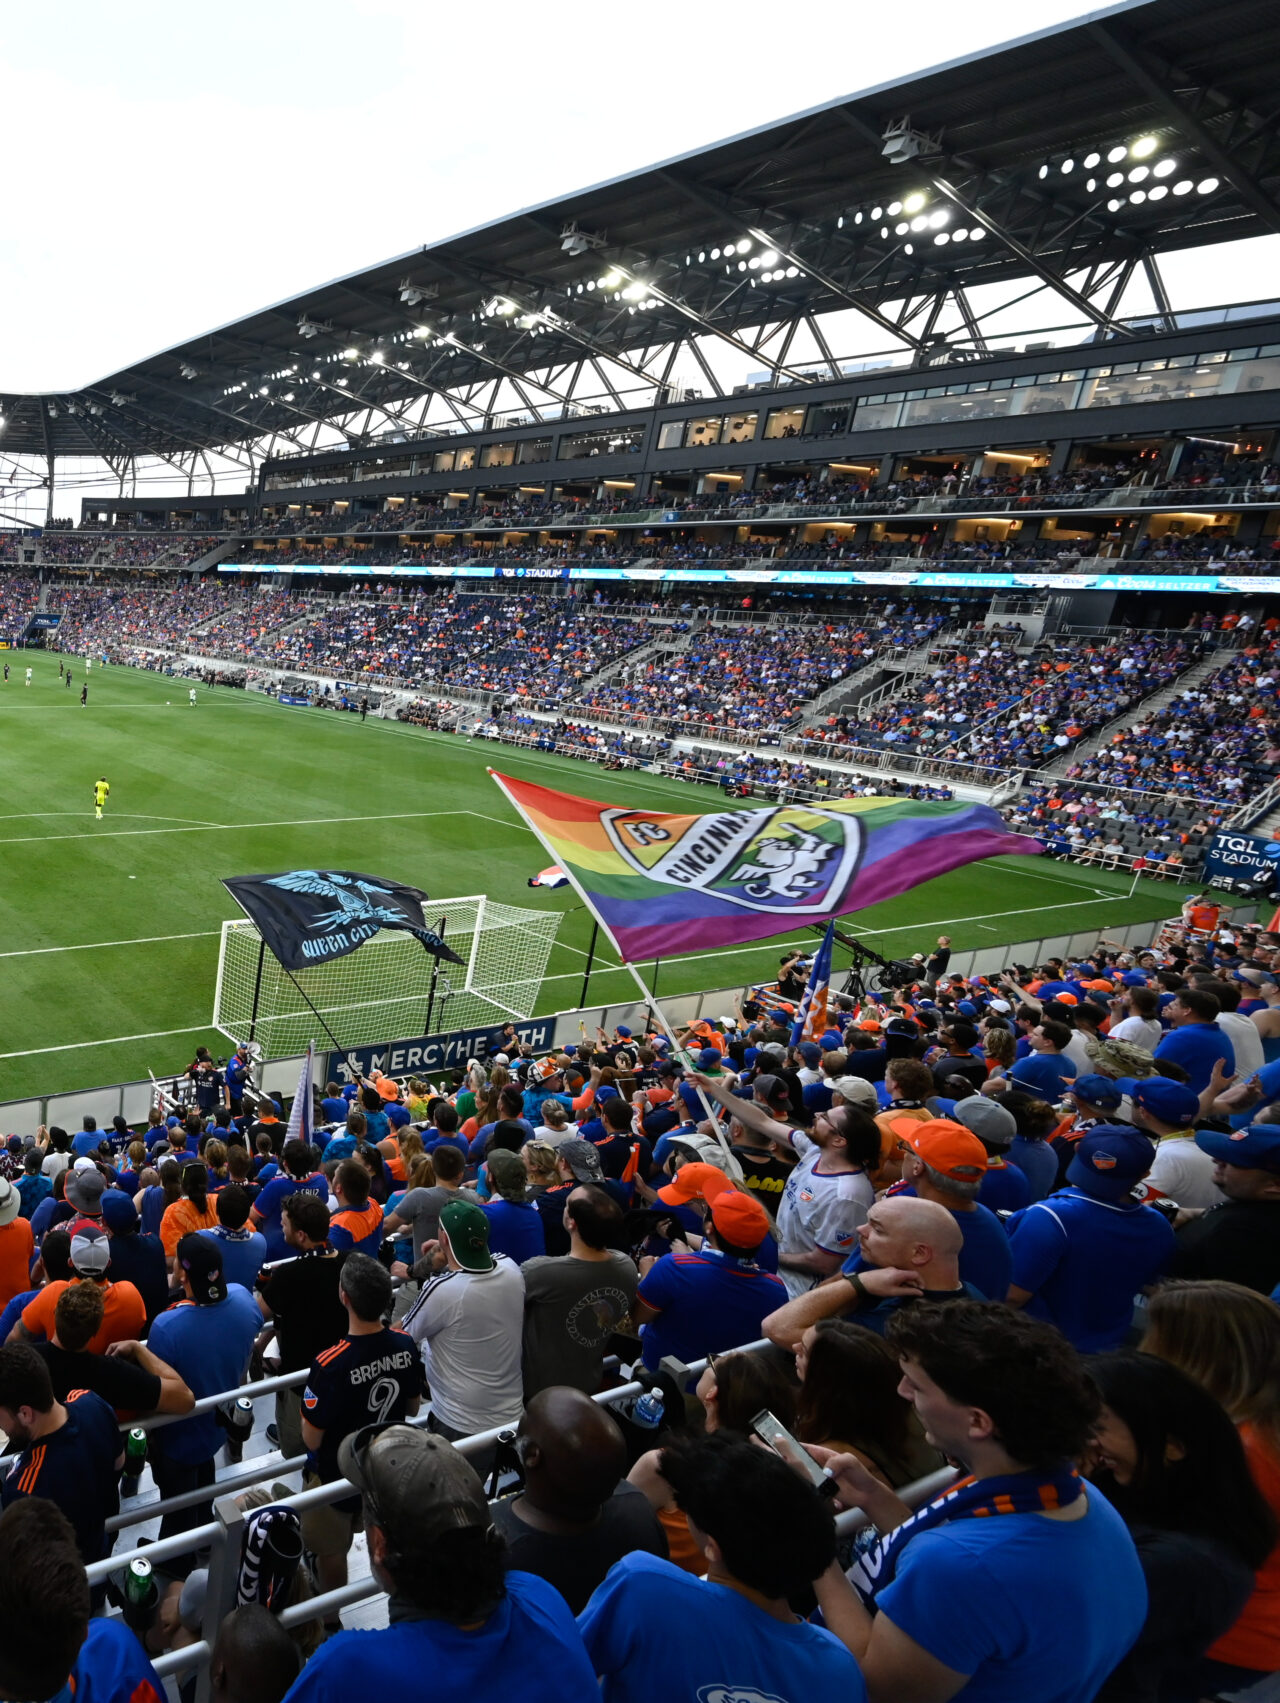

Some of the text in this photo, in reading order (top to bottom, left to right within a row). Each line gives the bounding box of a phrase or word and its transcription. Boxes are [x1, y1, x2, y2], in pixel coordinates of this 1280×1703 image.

[502, 568, 562, 578] TQL STADIUM
[1158, 582, 1211, 590] SELTZER
[623, 821, 671, 846] FC
[1216, 835, 1259, 855] TQL
[1210, 849, 1278, 870] STADIUM
[301, 932, 350, 959] QUEEN
[370, 1027, 546, 1071] MERCYHETH
[350, 1350, 412, 1385] BRENNER
[367, 1377, 400, 1424] 9
